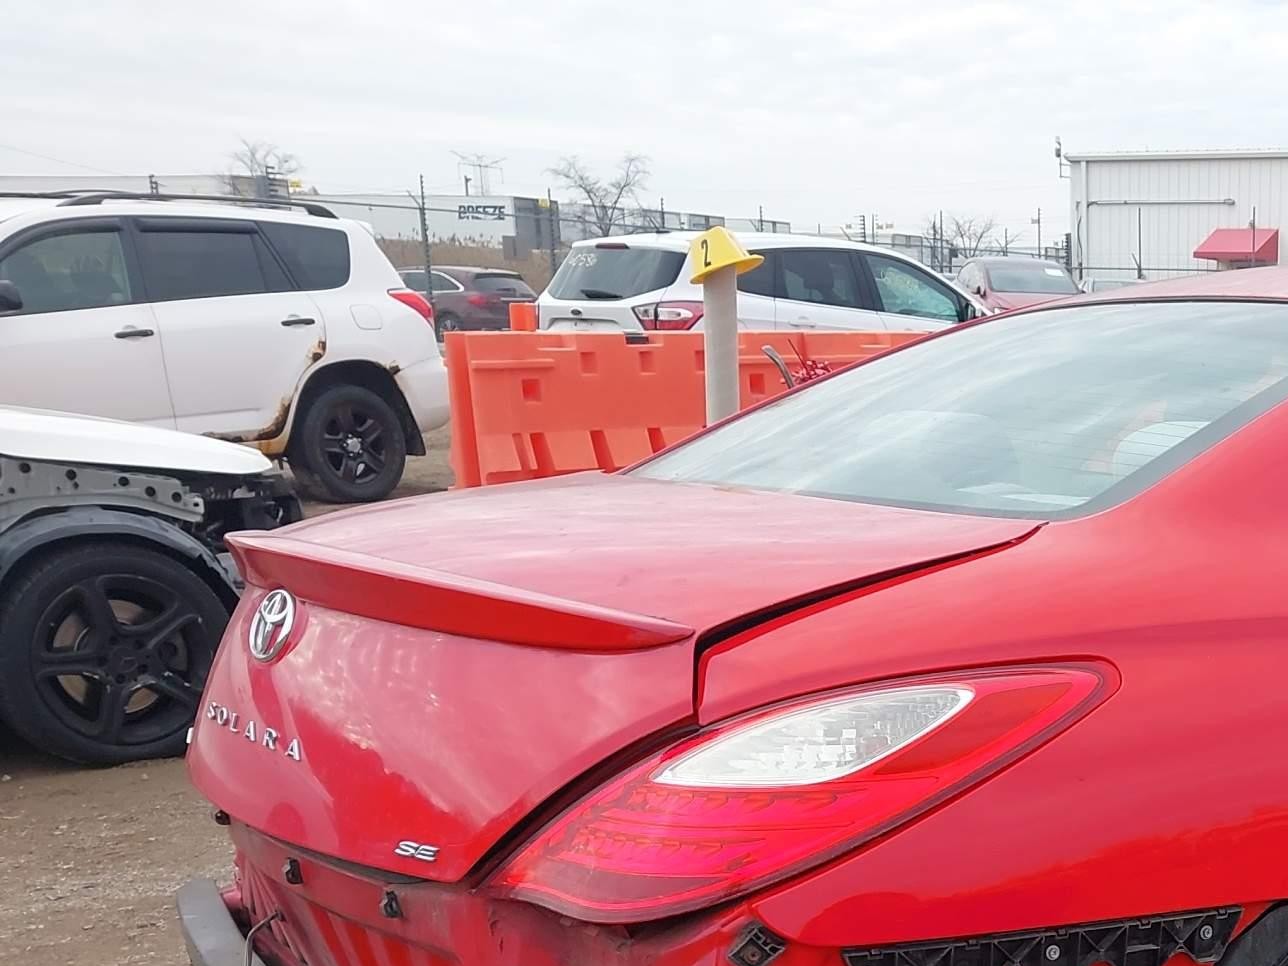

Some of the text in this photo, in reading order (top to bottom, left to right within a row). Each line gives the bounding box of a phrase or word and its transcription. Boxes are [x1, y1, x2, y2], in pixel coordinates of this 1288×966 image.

[701, 239, 711, 267] 2
[207, 702, 300, 761] SOLARA
[394, 841, 440, 861] SE
